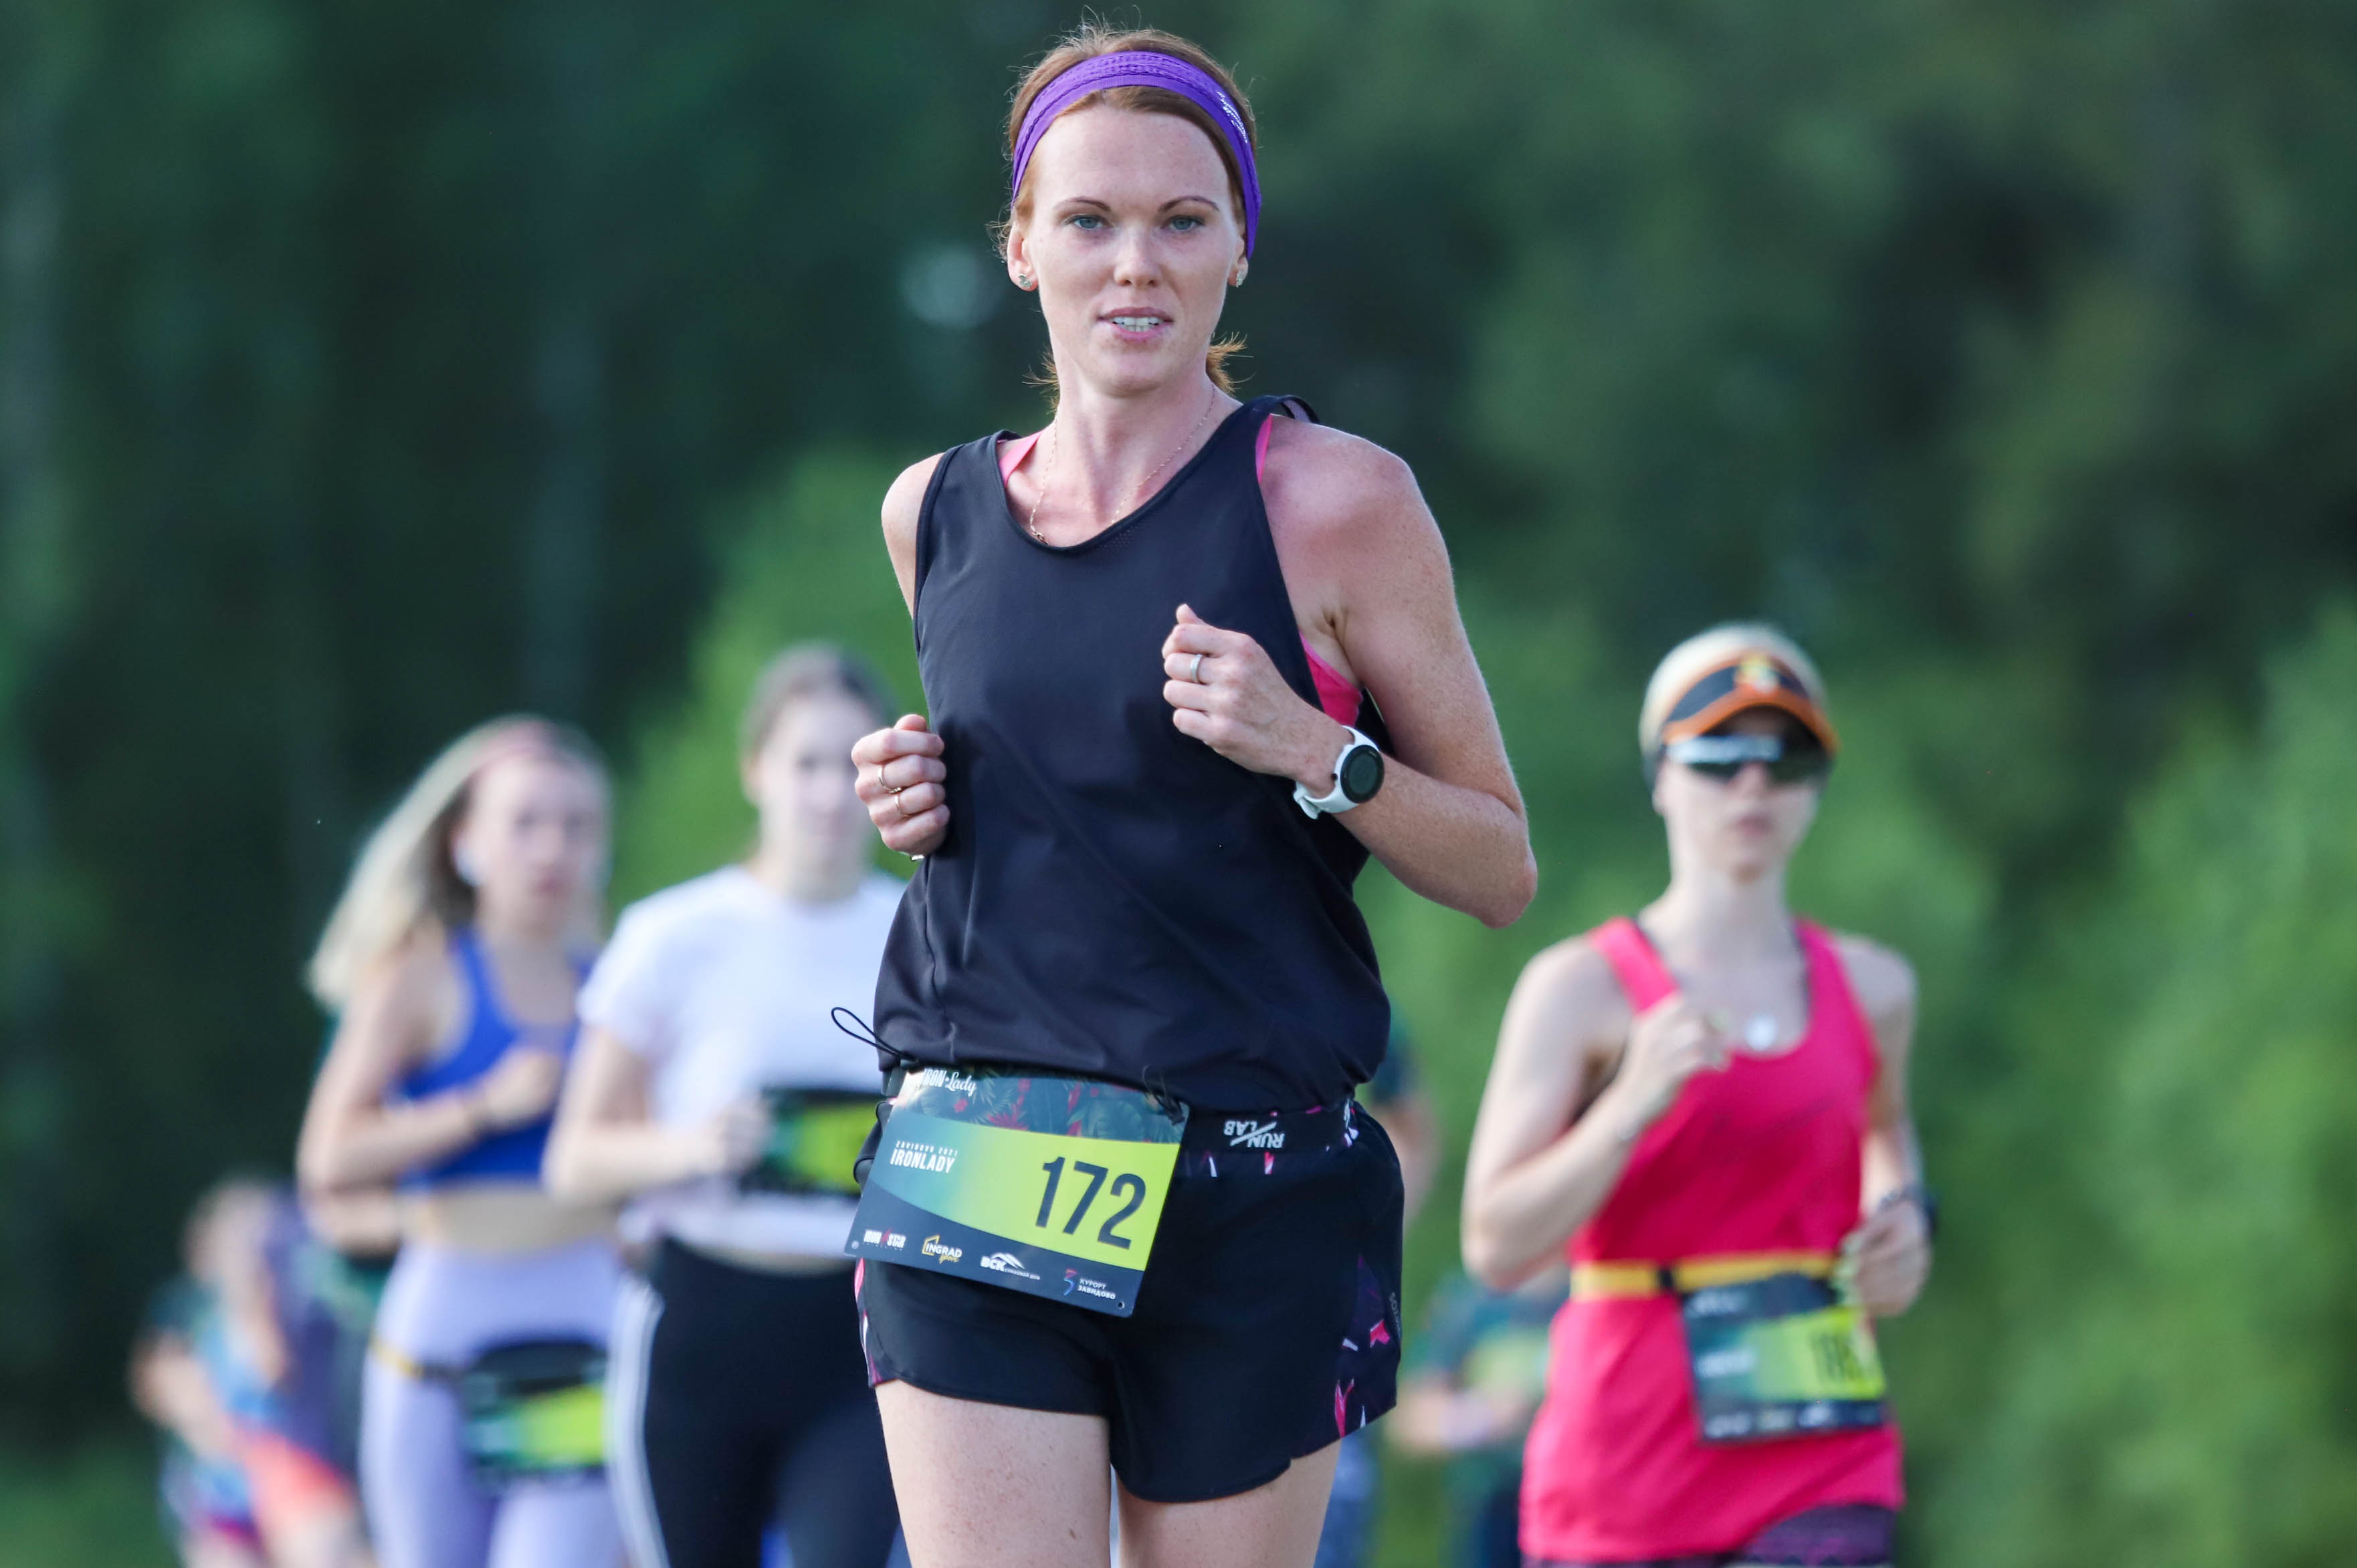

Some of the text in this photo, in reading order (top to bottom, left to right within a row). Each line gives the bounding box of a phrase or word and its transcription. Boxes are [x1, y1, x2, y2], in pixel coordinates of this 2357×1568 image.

[1223, 1120, 1257, 1136] LAB
[1247, 1132, 1285, 1148] RUN
[890, 1147, 956, 1173] IRONLADY
[1035, 1156, 1146, 1250] 172
[926, 1242, 962, 1258] INGRAD
[1079, 1278, 1106, 1290] КУРОРТ
[1078, 1284, 1116, 1301] ЗАВИДОВО
